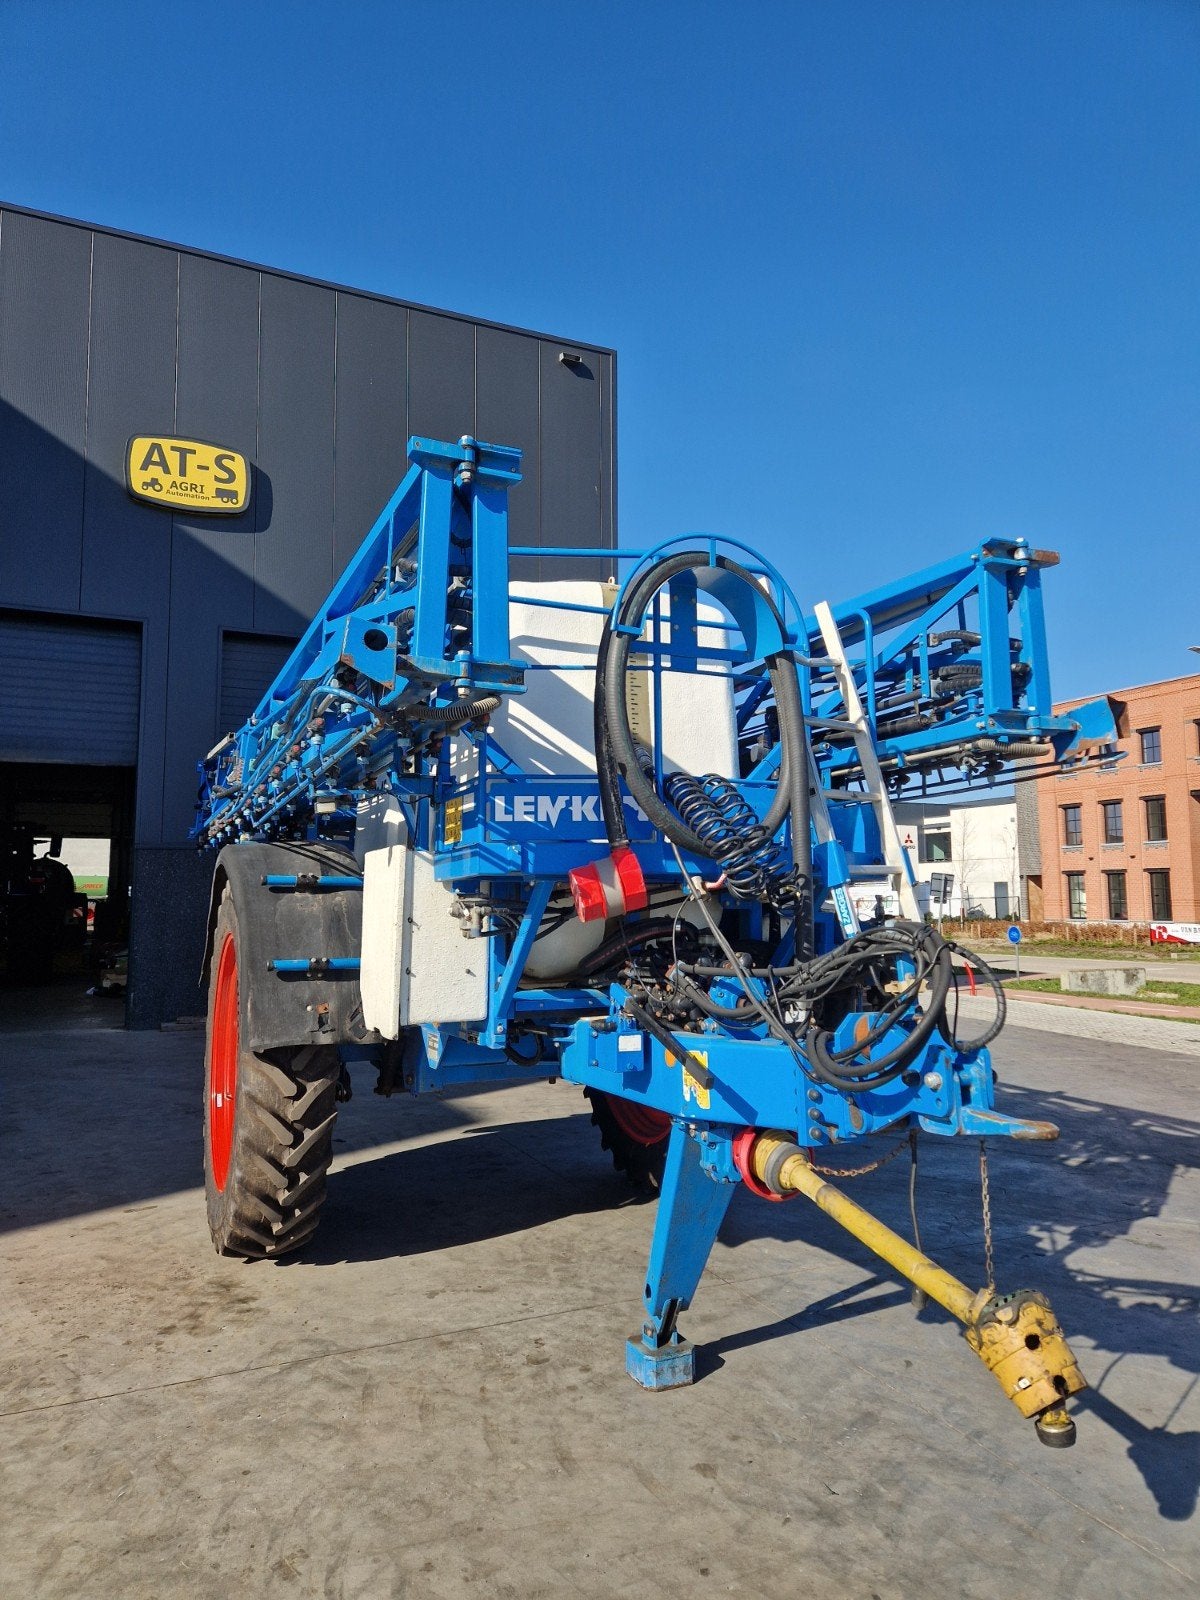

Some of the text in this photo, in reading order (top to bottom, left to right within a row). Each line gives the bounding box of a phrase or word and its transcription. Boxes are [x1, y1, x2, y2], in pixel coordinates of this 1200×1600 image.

[139, 442, 237, 485] AT-S
[165, 489, 210, 501] Automation
[169, 480, 205, 494] AGRI
[494, 795, 649, 828] LEMKN
[835, 887, 851, 925] ZARGES
